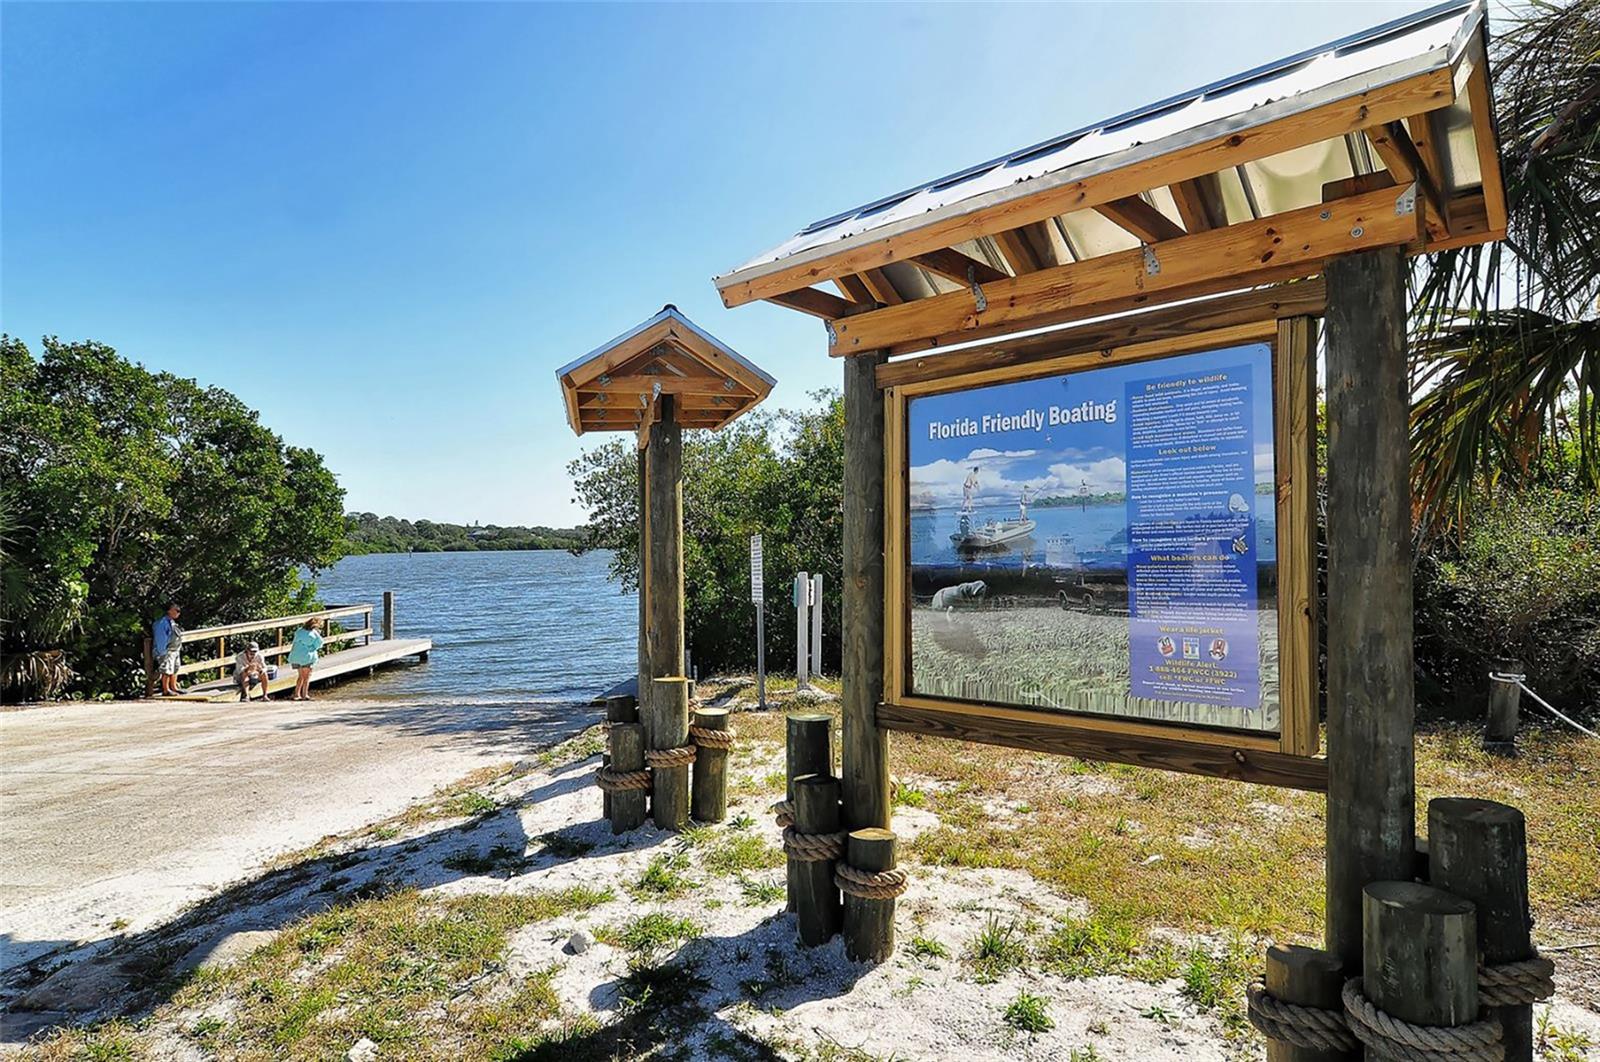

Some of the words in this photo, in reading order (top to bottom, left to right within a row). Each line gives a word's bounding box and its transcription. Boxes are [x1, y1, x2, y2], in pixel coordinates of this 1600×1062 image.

[1145, 383, 1156, 391] Be
[1157, 380, 1186, 389] friendly
[1199, 374, 1228, 383] wildlife
[928, 416, 978, 440] Florida
[982, 409, 1045, 435] Friendly
[1049, 399, 1118, 426] Boating
[1159, 625, 1178, 633] Wear
[1199, 627, 1224, 635] jacket
[1165, 659, 1194, 667] Wildlife
